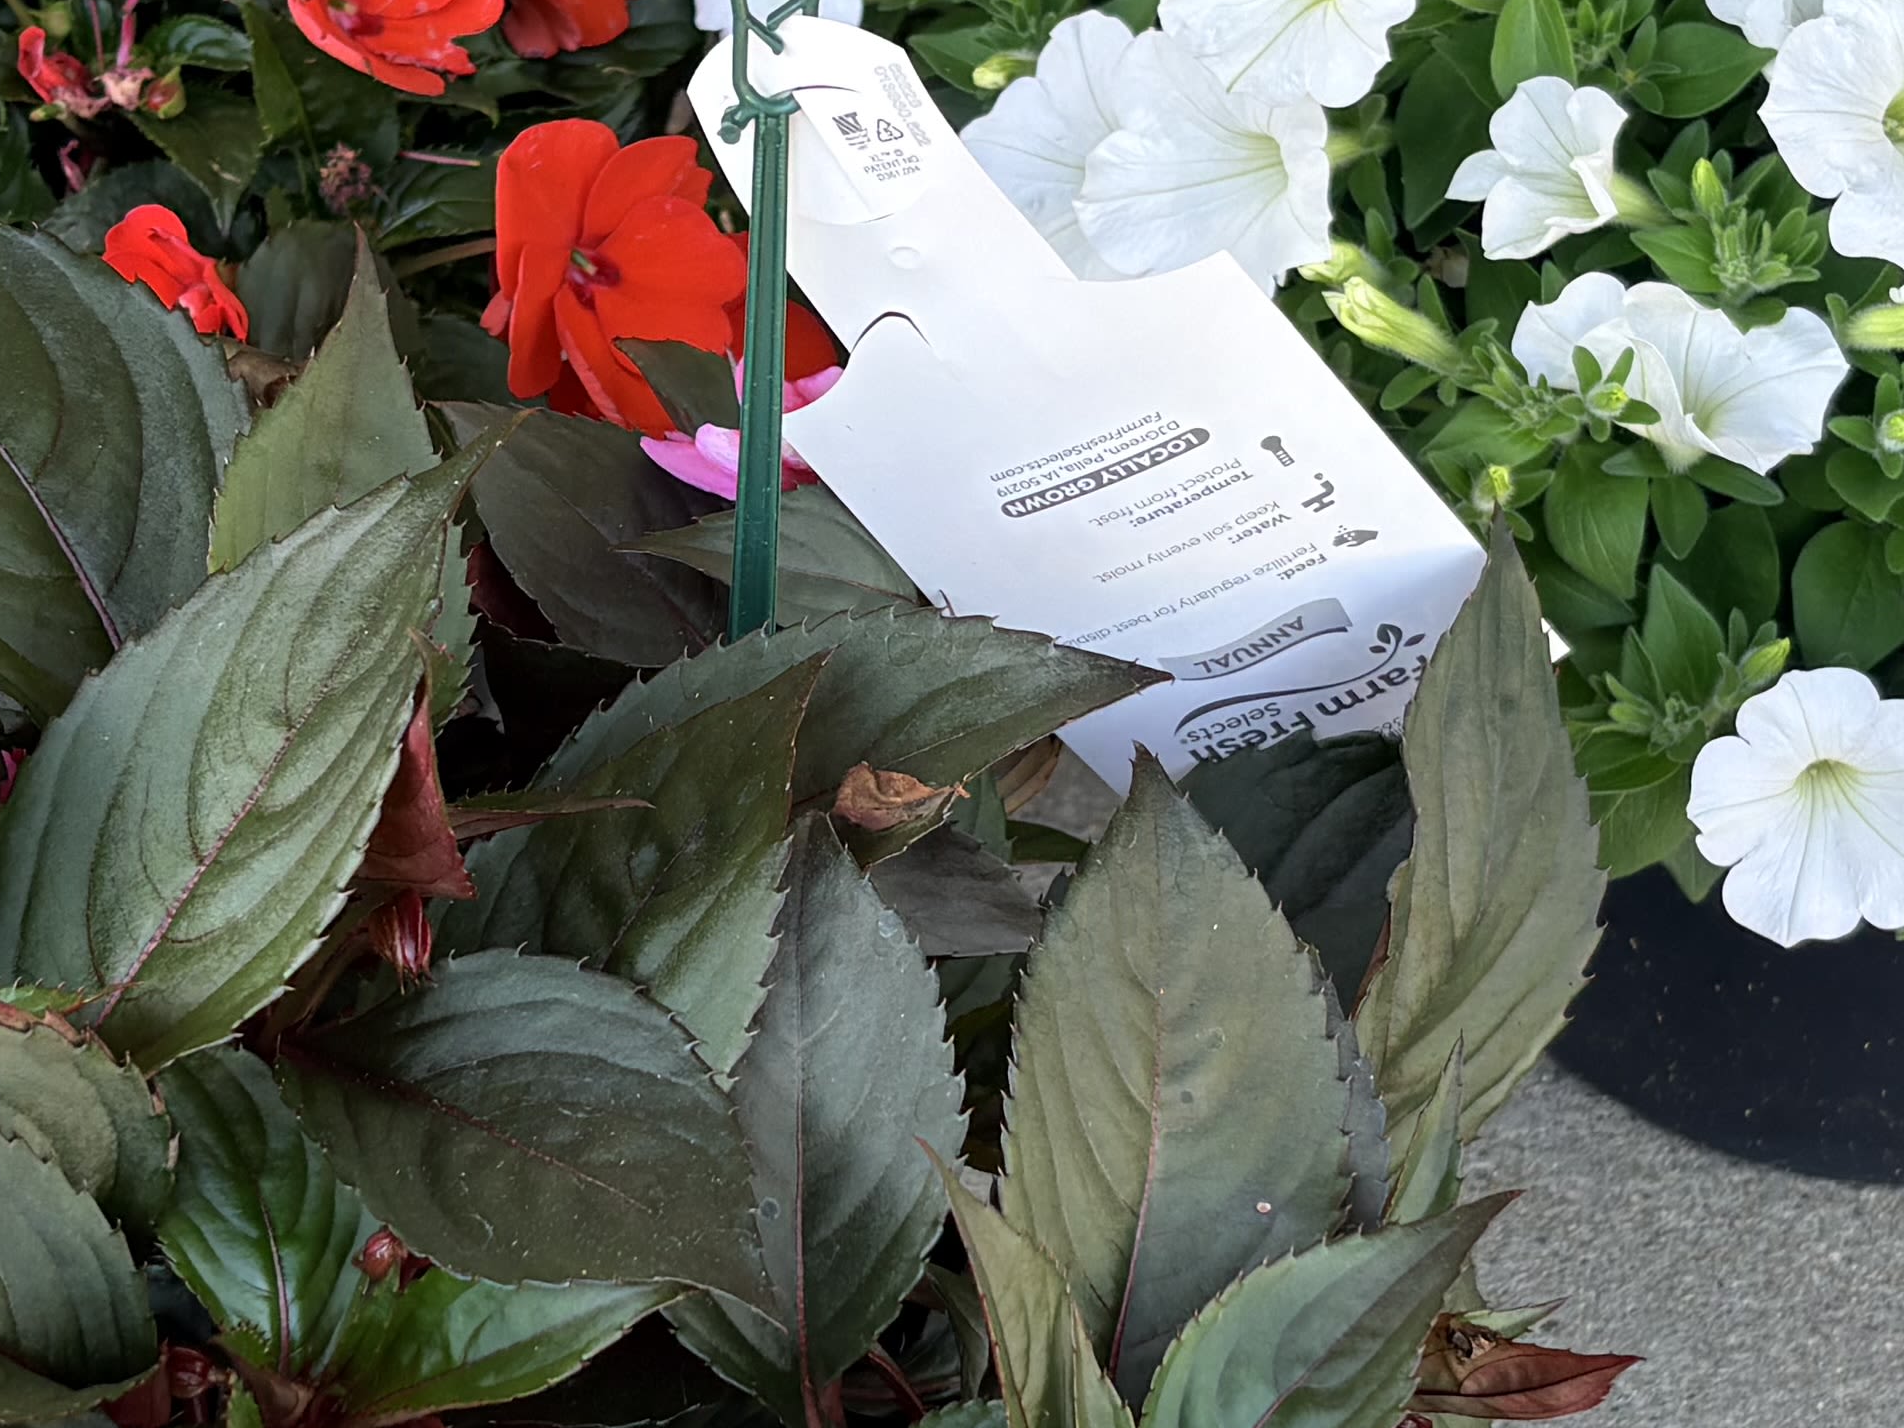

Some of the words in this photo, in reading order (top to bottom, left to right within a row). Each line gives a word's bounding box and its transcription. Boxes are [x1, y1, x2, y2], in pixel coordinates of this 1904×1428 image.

[990, 412, 1162, 482] FarmFreshSelects.com
[1104, 420, 1180, 454] DJGreen,
[1059, 453, 1104, 472] Pella,
[1100, 430, 1199, 483] LOCALLY
[997, 477, 1040, 497] 50219
[1041, 470, 1060, 480] IA
[1178, 458, 1242, 491] Protect
[1006, 479, 1096, 517] GROWN
[1130, 471, 1253, 527] Temperature:
[1134, 488, 1177, 509] from
[1088, 507, 1133, 526] frost.
[1235, 501, 1280, 525] Keep
[1203, 523, 1232, 541] soil
[1228, 514, 1291, 544] Water:
[1148, 538, 1200, 564] evenly
[1253, 543, 1317, 576] Fertilize
[1093, 560, 1144, 583] moist.
[1277, 554, 1327, 580] Feed:
[1180, 574, 1251, 608] regularly
[1112, 614, 1152, 632] best
[1154, 605, 1177, 618] for
[1193, 615, 1304, 674] ANNUAL
